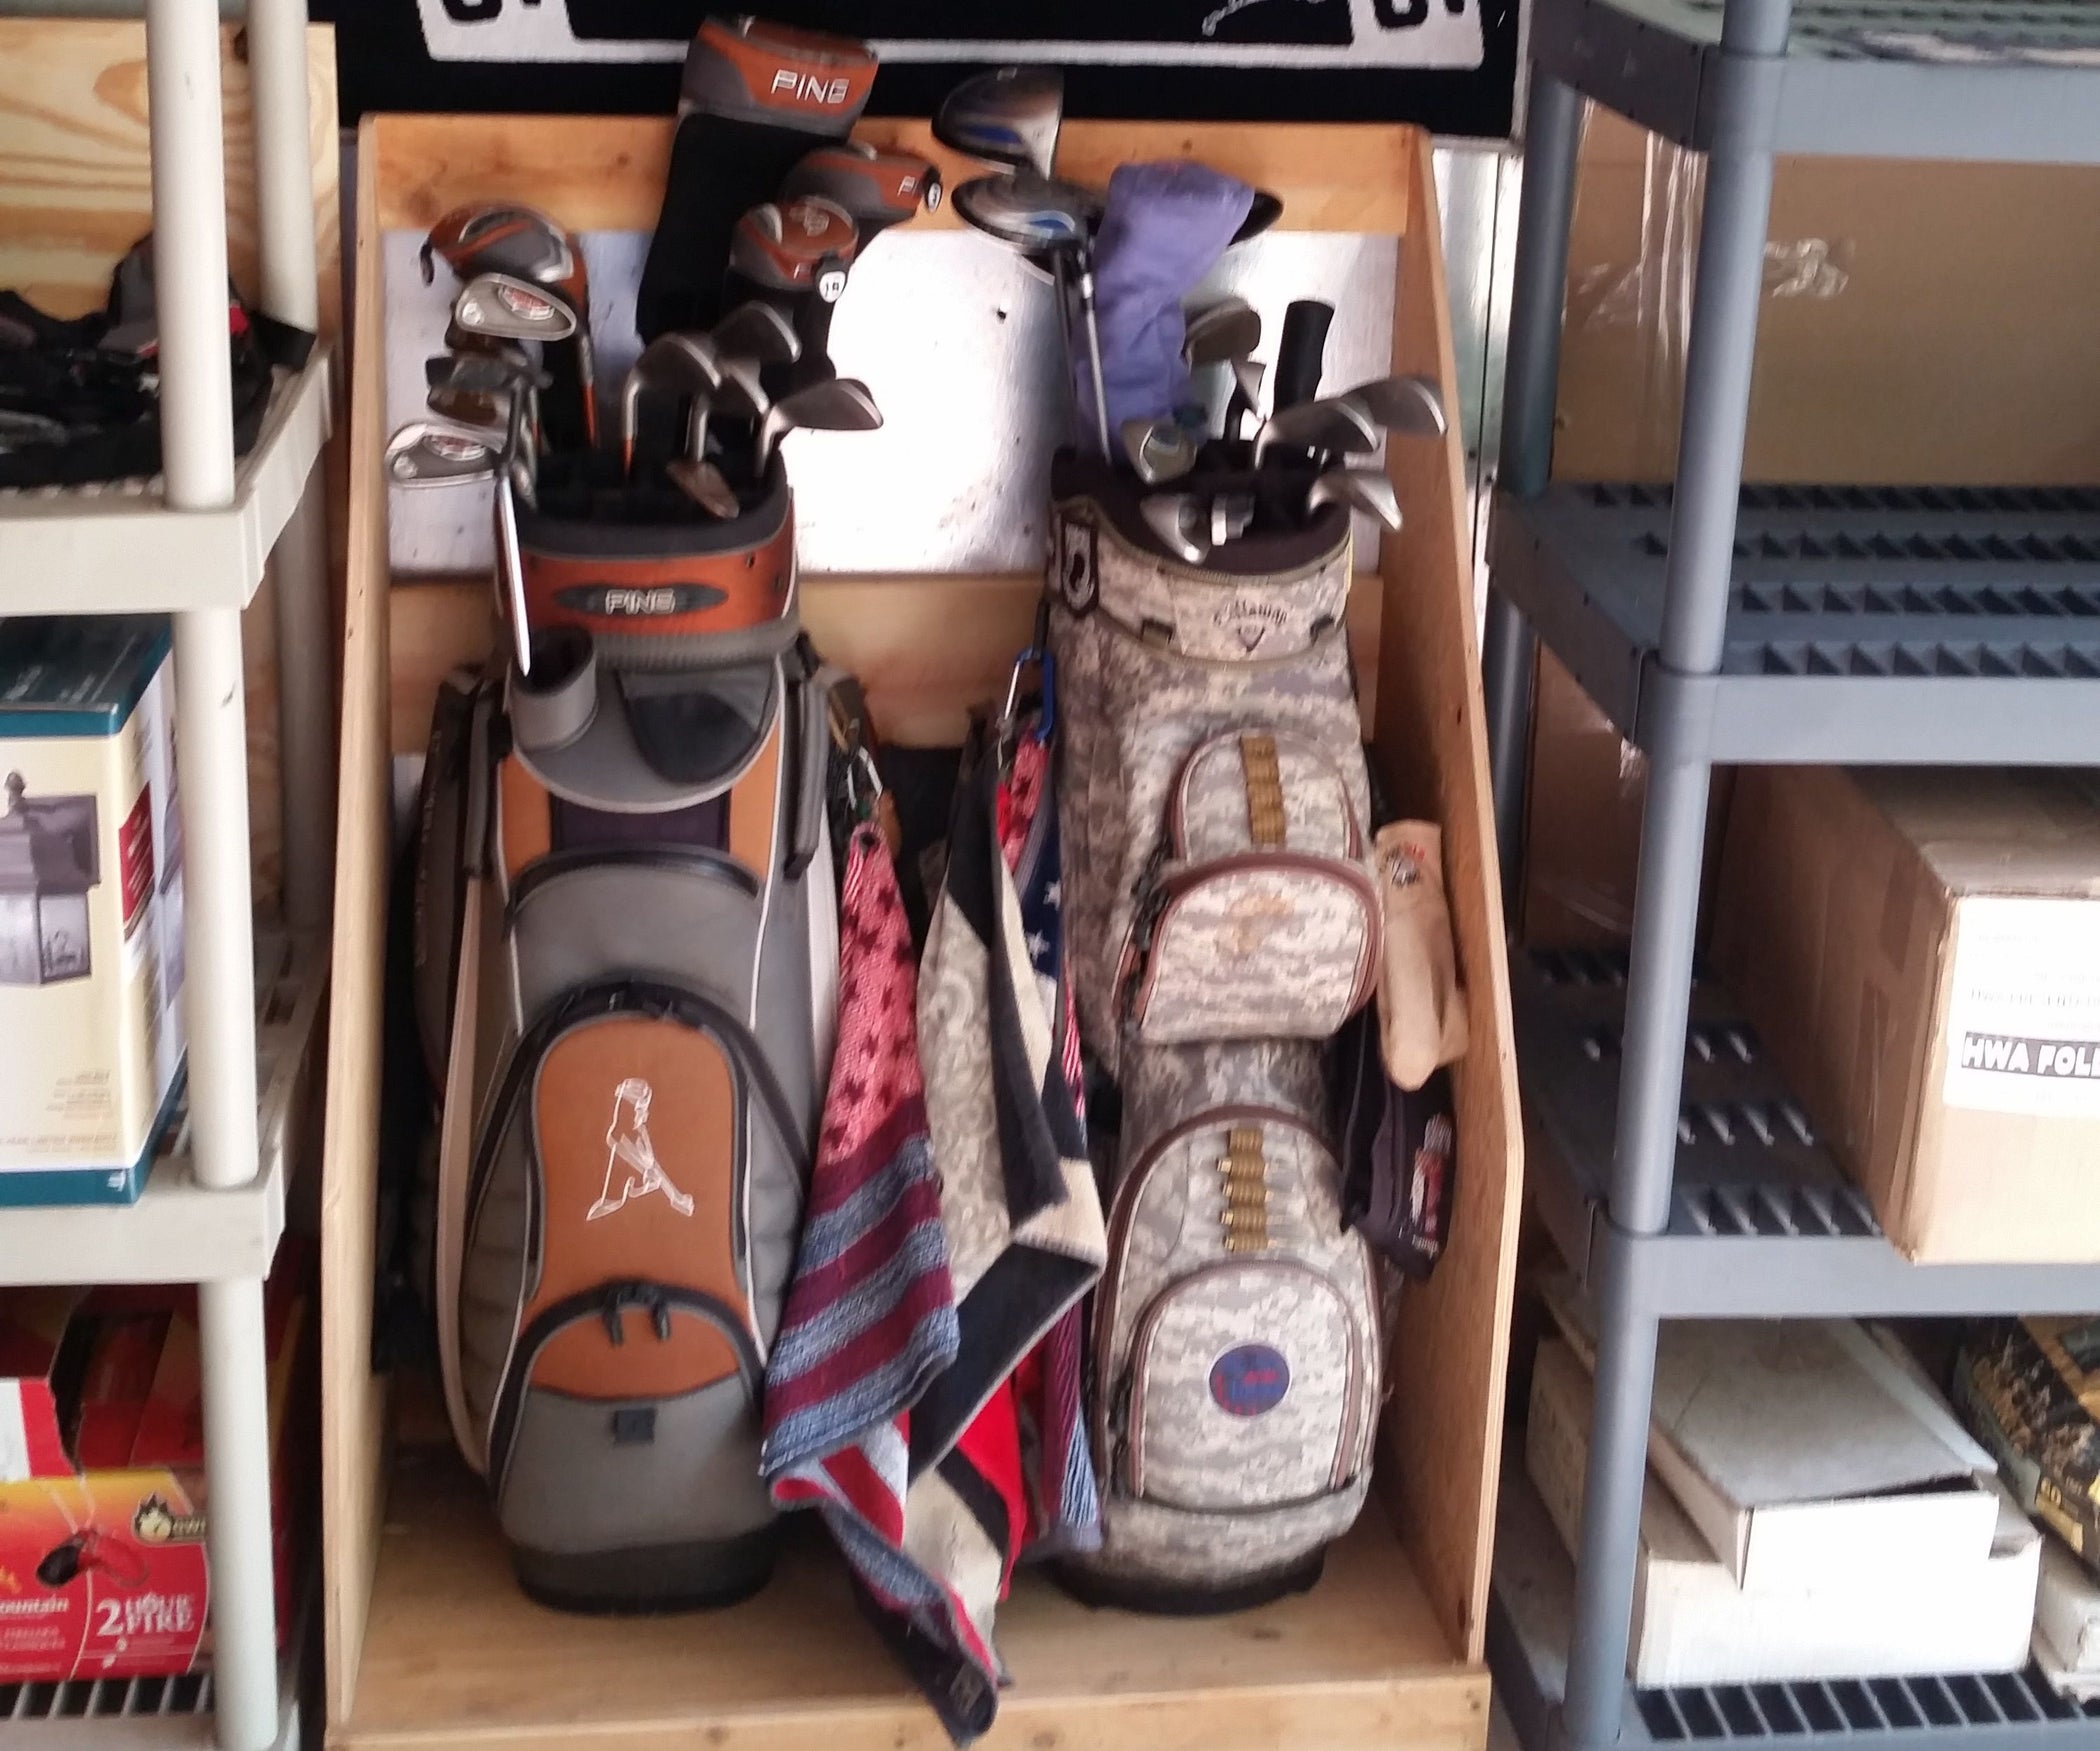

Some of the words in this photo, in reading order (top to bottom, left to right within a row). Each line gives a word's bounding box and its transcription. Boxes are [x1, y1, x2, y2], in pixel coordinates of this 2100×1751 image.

[771, 69, 850, 104] PING
[605, 588, 675, 615] PING
[1962, 1036, 2031, 1073] HWA
[96, 1597, 124, 1637] 2
